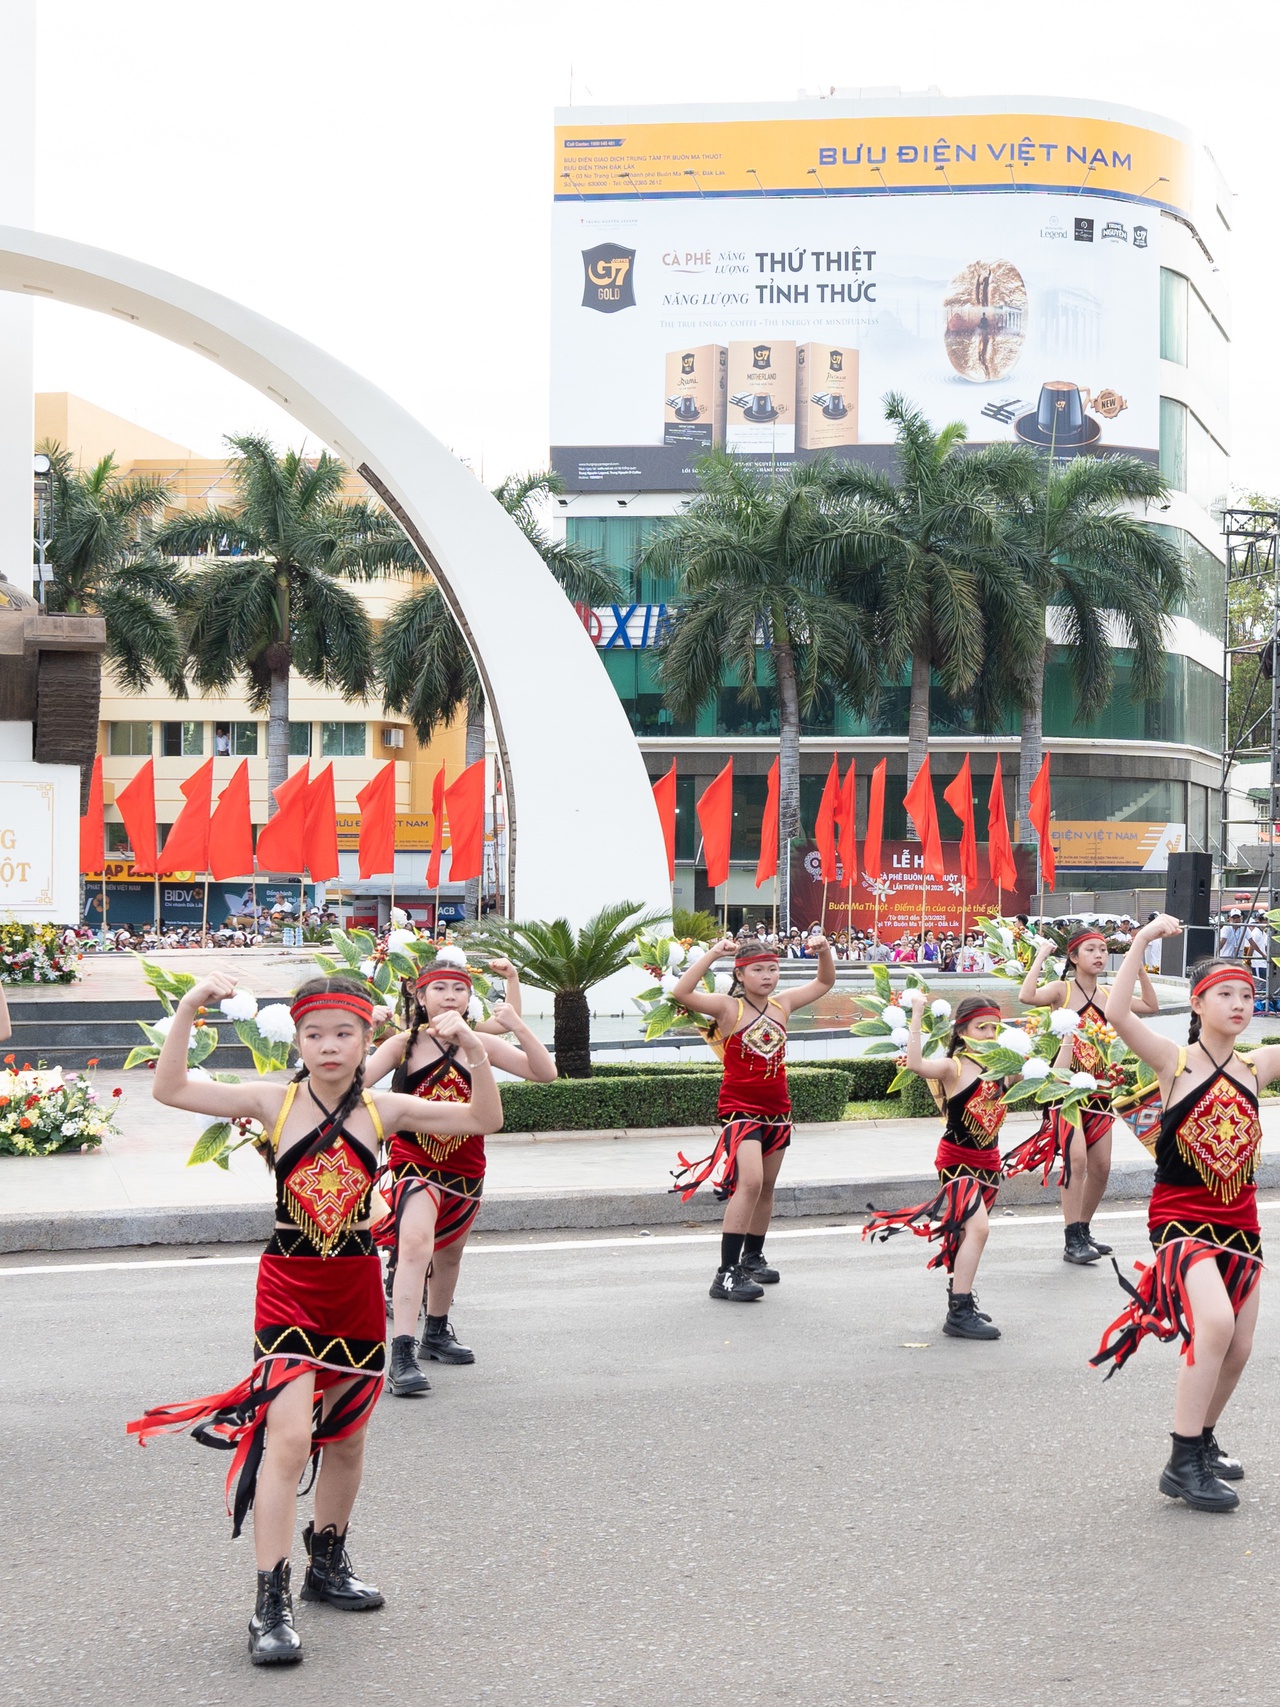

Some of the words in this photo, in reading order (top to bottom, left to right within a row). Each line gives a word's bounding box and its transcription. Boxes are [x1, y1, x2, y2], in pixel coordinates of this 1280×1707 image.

[819, 143, 886, 166] BƯU
[986, 136, 1058, 166] VIỆT
[1066, 145, 1132, 171] NAM
[1040, 229, 1068, 240] Legend
[662, 250, 681, 266] CÀ
[685, 248, 712, 266] PHÊ
[718, 251, 746, 261] NĂNG
[755, 246, 806, 273] THỨ
[811, 245, 877, 276] THIỆT
[715, 264, 750, 275] LƯỢNG
[598, 288, 620, 300] GOLD
[755, 277, 809, 304] TỈNH
[816, 278, 877, 303] THỨC
[662, 291, 699, 306] NĂNG
[702, 291, 750, 308] LƯỢNG
[747, 373, 777, 381] MOTHERLAND
[1101, 397, 1116, 410] NEW
[405, 820, 429, 828] NAM
[1051, 829, 1083, 841] ĐIỆN
[1086, 829, 1113, 842] VIỆT
[1115, 832, 1138, 841] NAM
[893, 849, 911, 868] LỄ
[888, 871, 903, 881] PHÊ
[903, 872, 923, 882] BUÔN
[892, 882, 903, 891] LẦN
[903, 883, 914, 891] THỨ
[930, 884, 944, 892] 2025
[164, 889, 193, 902] BIDV
[438, 906, 455, 915] ACB
[829, 902, 850, 911] Buôn
[851, 902, 864, 911] Ma
[894, 902, 915, 912] Điểm
[932, 903, 946, 913] của
[947, 904, 956, 913] cà
[973, 903, 985, 913] thế
[938, 920, 948, 928] Đắk
[950, 920, 960, 928] Lắk
